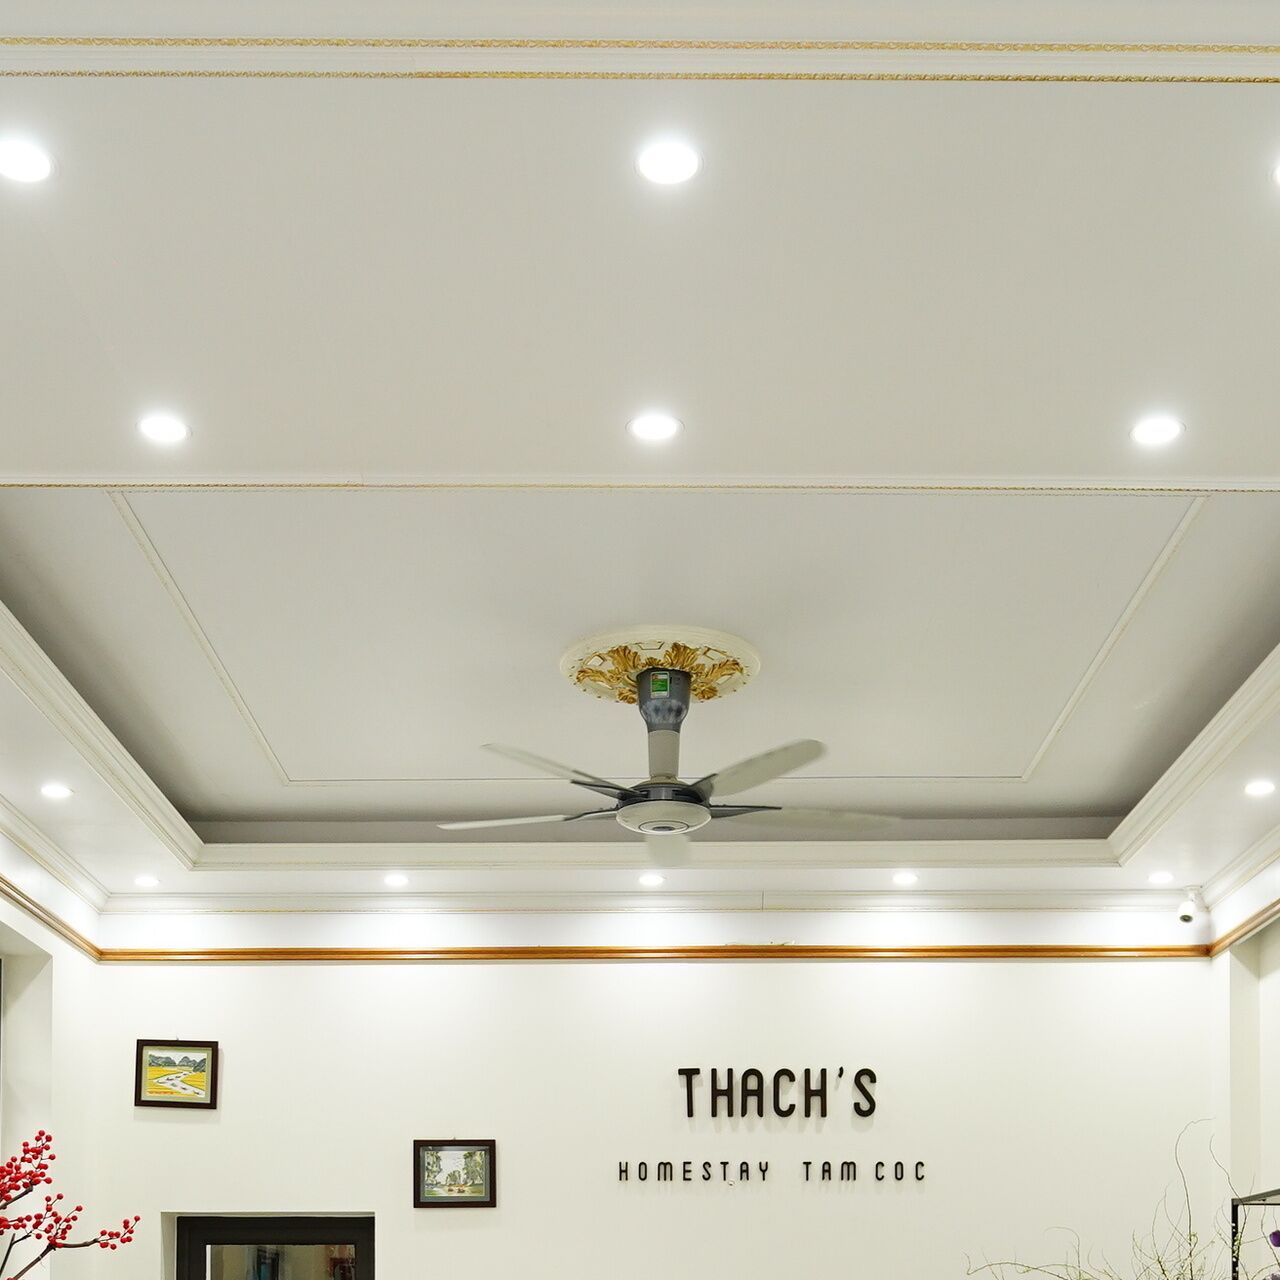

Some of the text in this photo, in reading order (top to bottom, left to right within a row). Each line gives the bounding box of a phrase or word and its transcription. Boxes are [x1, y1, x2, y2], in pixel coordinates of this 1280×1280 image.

[677, 1066, 877, 1118] THACH'S
[618, 1161, 926, 1182] HOMESTAY TAM COC
